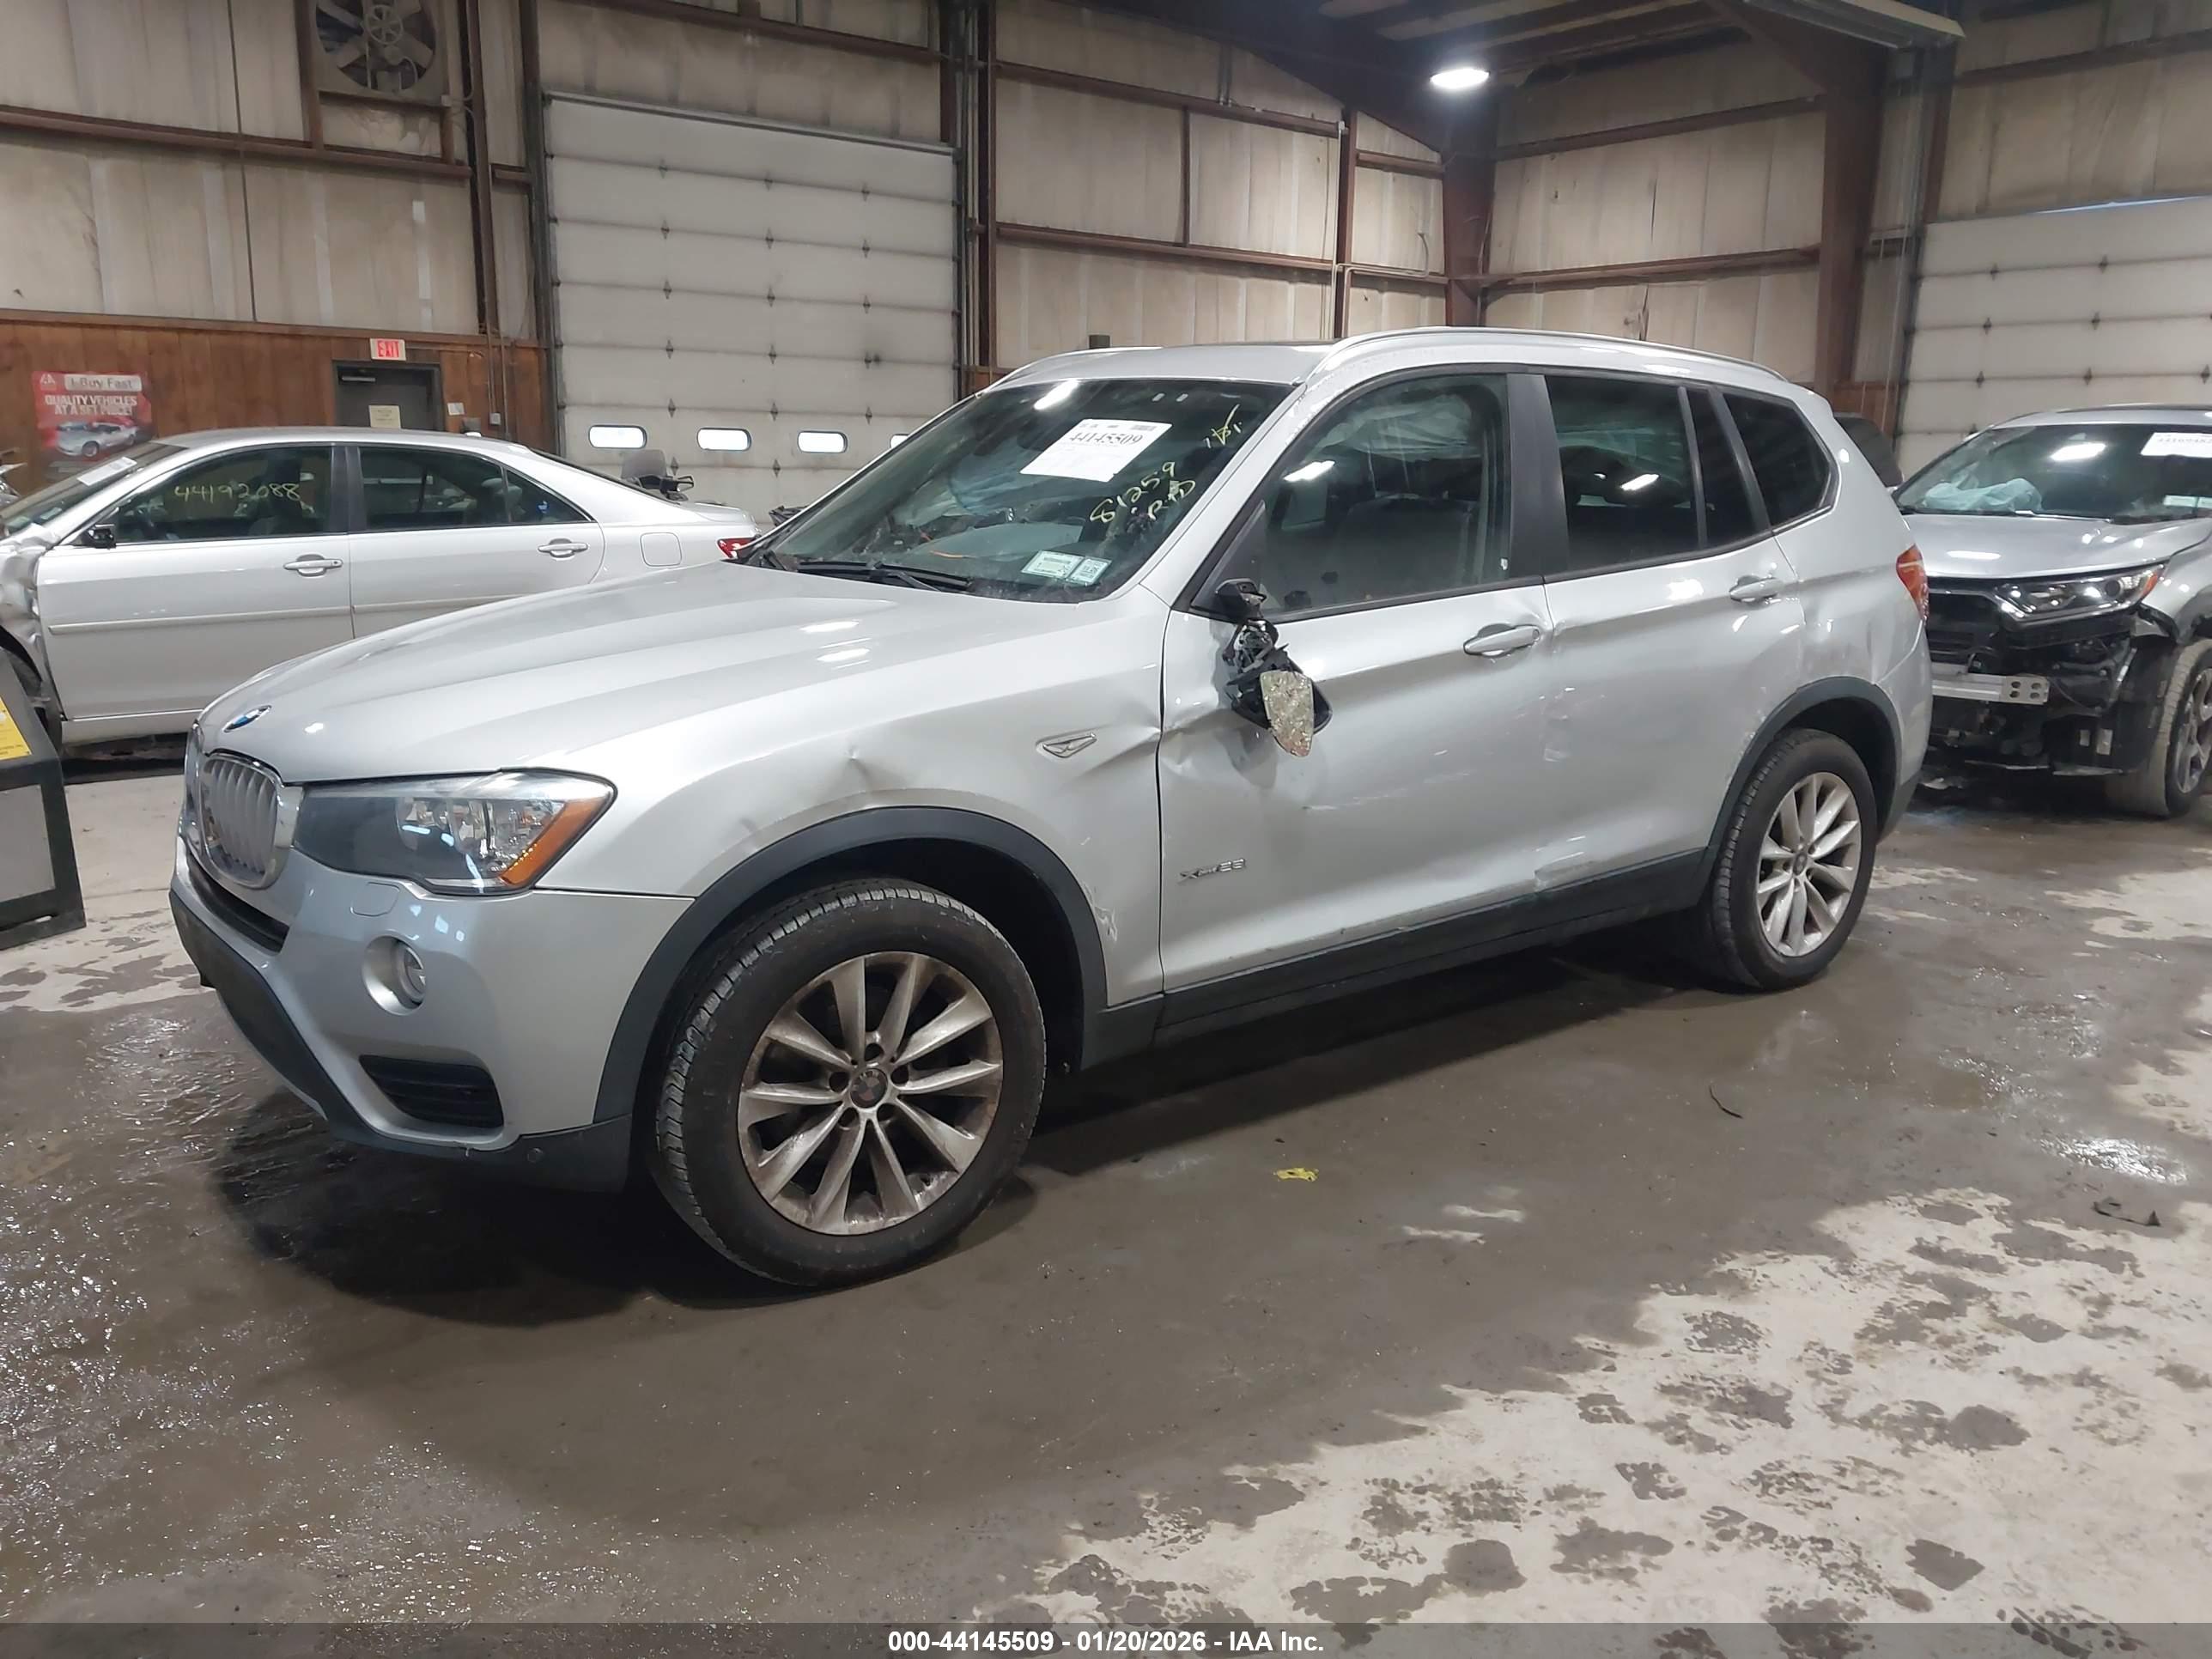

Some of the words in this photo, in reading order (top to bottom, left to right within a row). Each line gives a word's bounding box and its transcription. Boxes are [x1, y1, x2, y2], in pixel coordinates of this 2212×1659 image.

[378, 340, 399, 358] EXIT
[107, 378, 132, 389] Fast
[45, 394, 88, 406] QUALITY
[88, 395, 138, 406] VEHICLES
[54, 405, 68, 415] AT
[70, 405, 79, 415] A
[174, 483, 301, 504] 44192088
